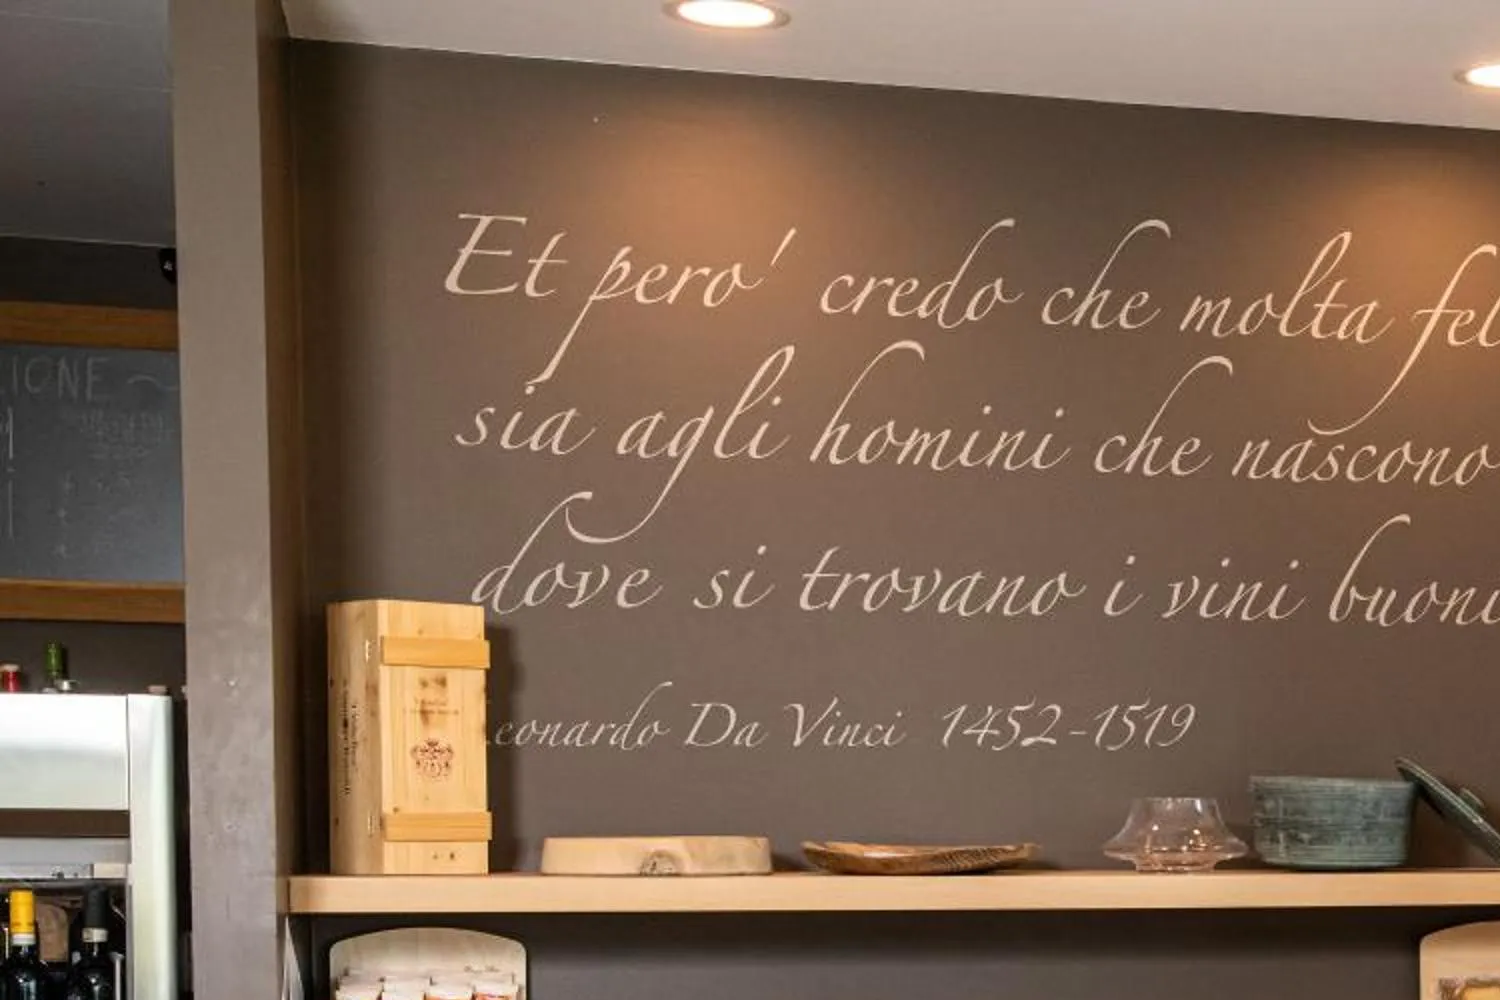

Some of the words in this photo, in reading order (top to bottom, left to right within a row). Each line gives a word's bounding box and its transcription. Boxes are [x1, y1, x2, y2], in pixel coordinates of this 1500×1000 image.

[444, 213, 567, 298] Et
[821, 219, 1024, 329] credo
[1040, 219, 1171, 330] che
[1180, 232, 1396, 345] molta
[456, 385, 596, 456] sia
[564, 345, 795, 543] agli
[810, 340, 1072, 470] homini
[1094, 356, 1233, 477] che
[471, 491, 664, 615] dove
[693, 545, 776, 609] si
[799, 546, 1087, 617] trovano
[1103, 555, 1142, 618] i
[1162, 557, 1306, 621] vini
[487, 681, 673, 751] eonardo
[684, 702, 768, 748] Da
[784, 697, 906, 749] Vinci
